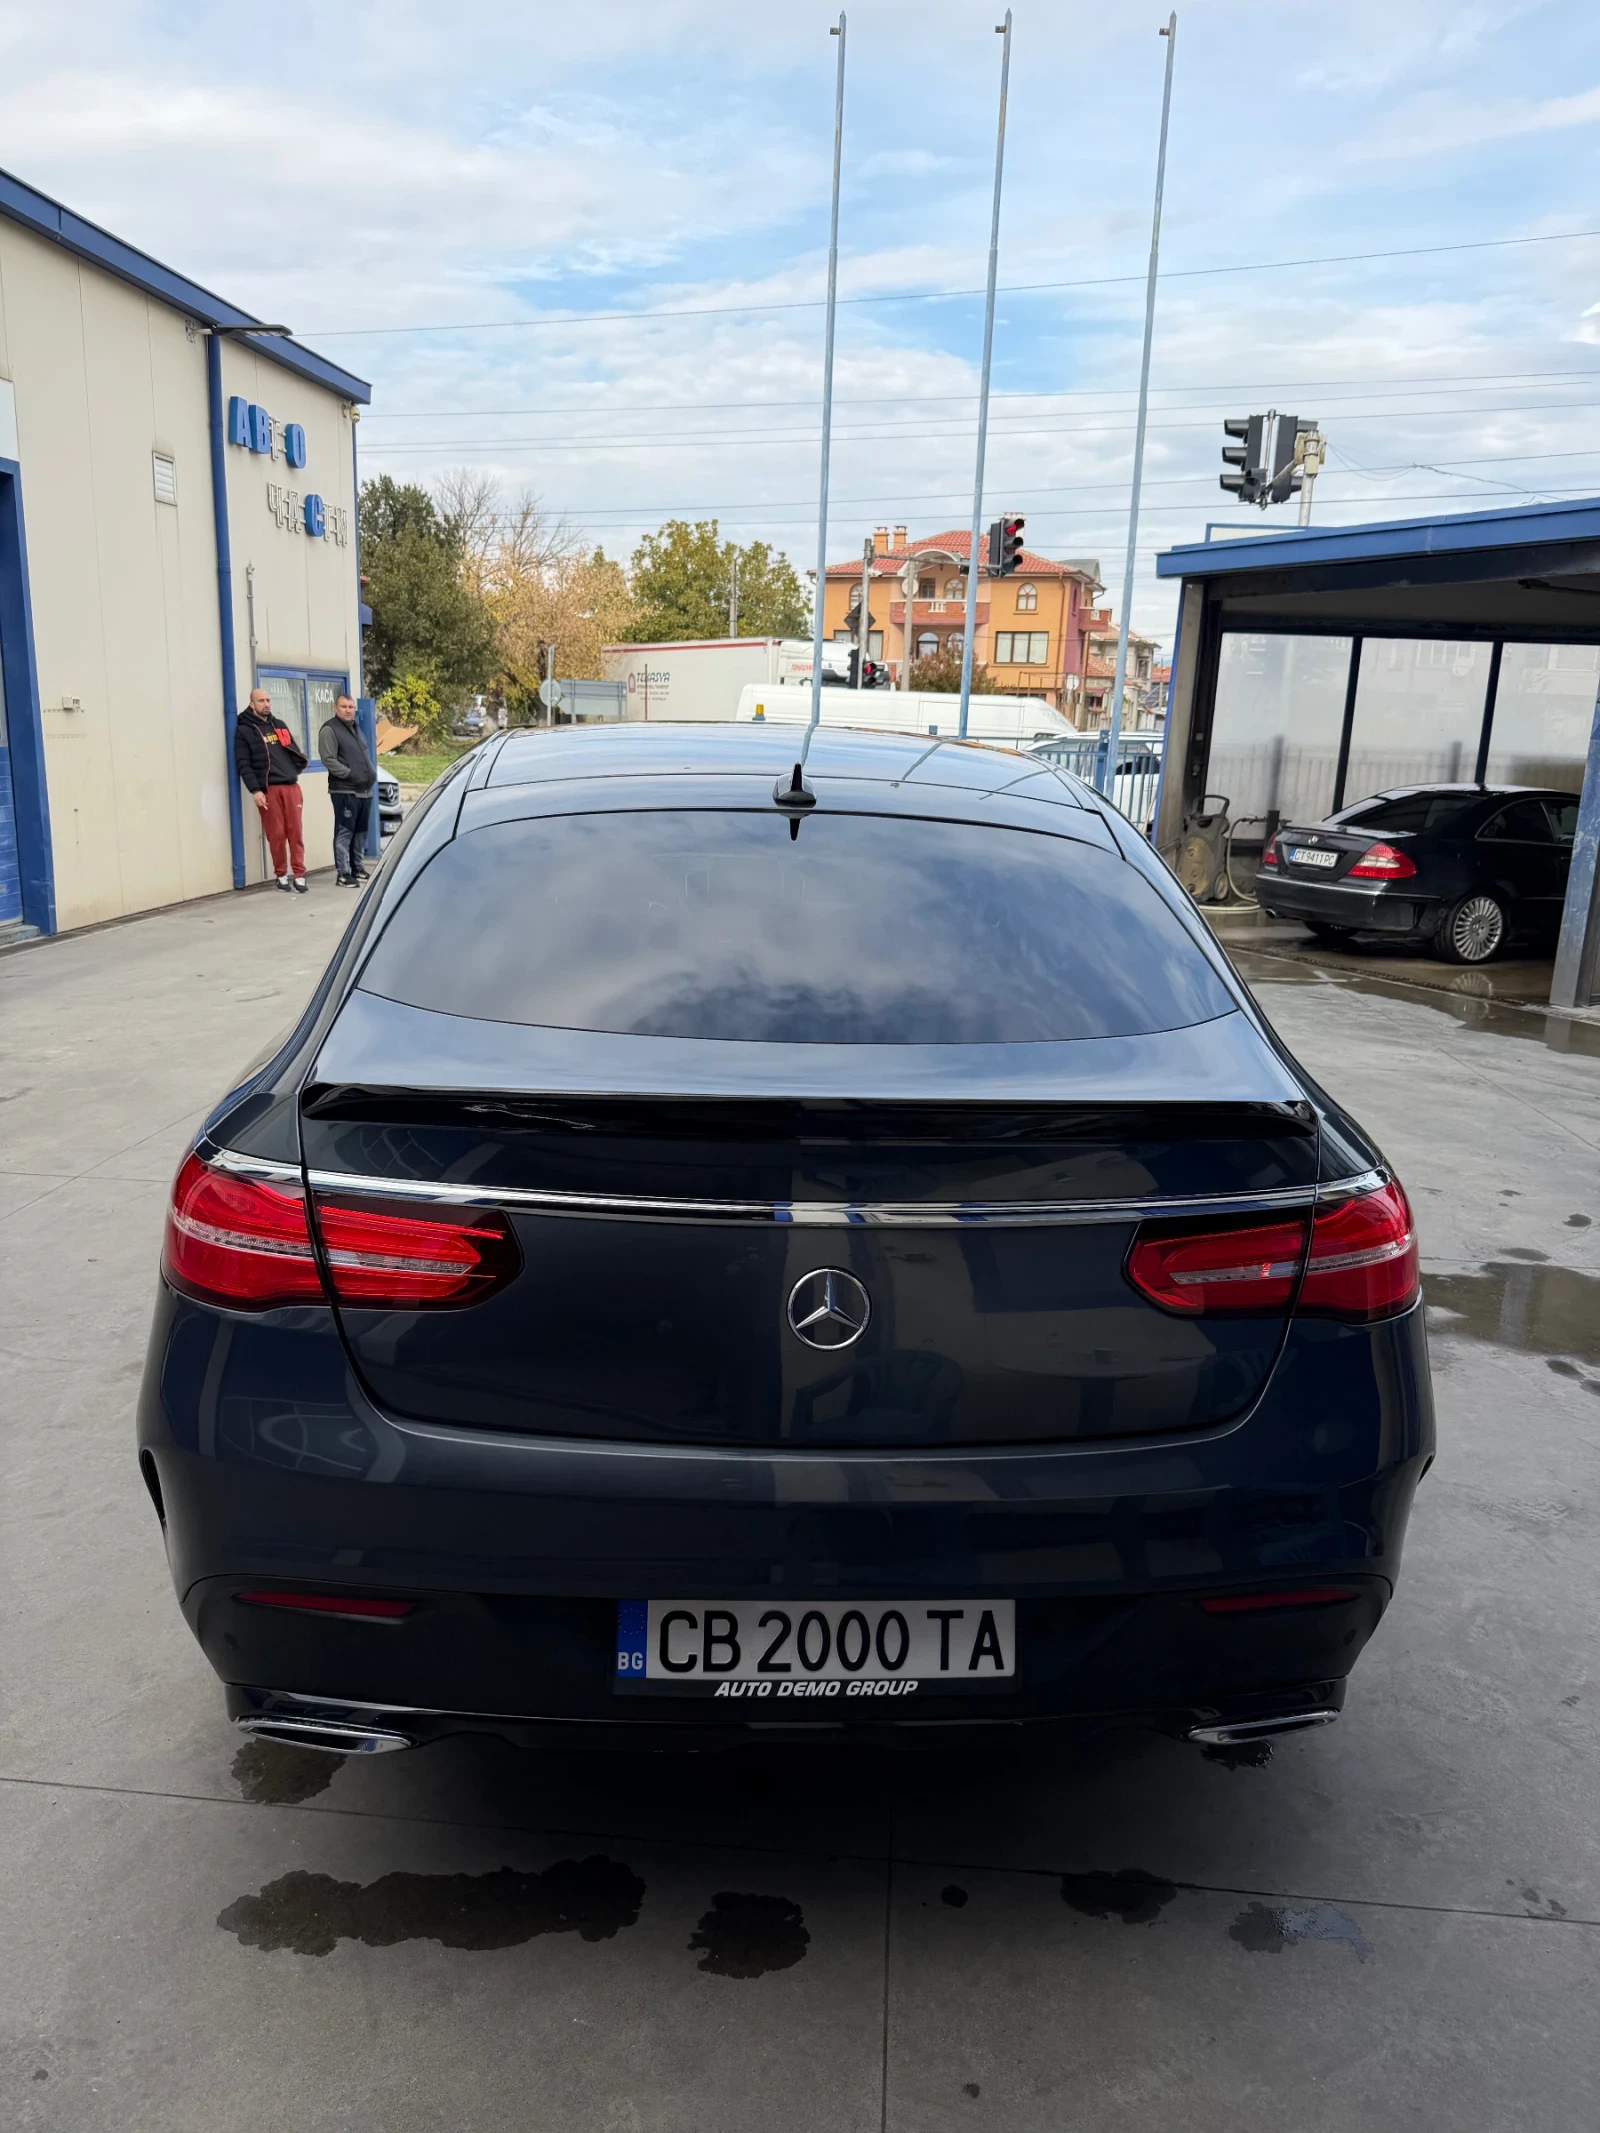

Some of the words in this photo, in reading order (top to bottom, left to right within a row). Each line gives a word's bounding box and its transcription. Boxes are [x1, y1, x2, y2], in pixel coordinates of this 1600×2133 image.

[659, 1610, 740, 1673] CB
[757, 1610, 909, 1672] 2000
[927, 1609, 1004, 1671] TA
[617, 1652, 643, 1670] BG
[714, 1682, 772, 1697] AUTO
[777, 1681, 840, 1696] DEMO
[846, 1680, 918, 1696] GROUP
